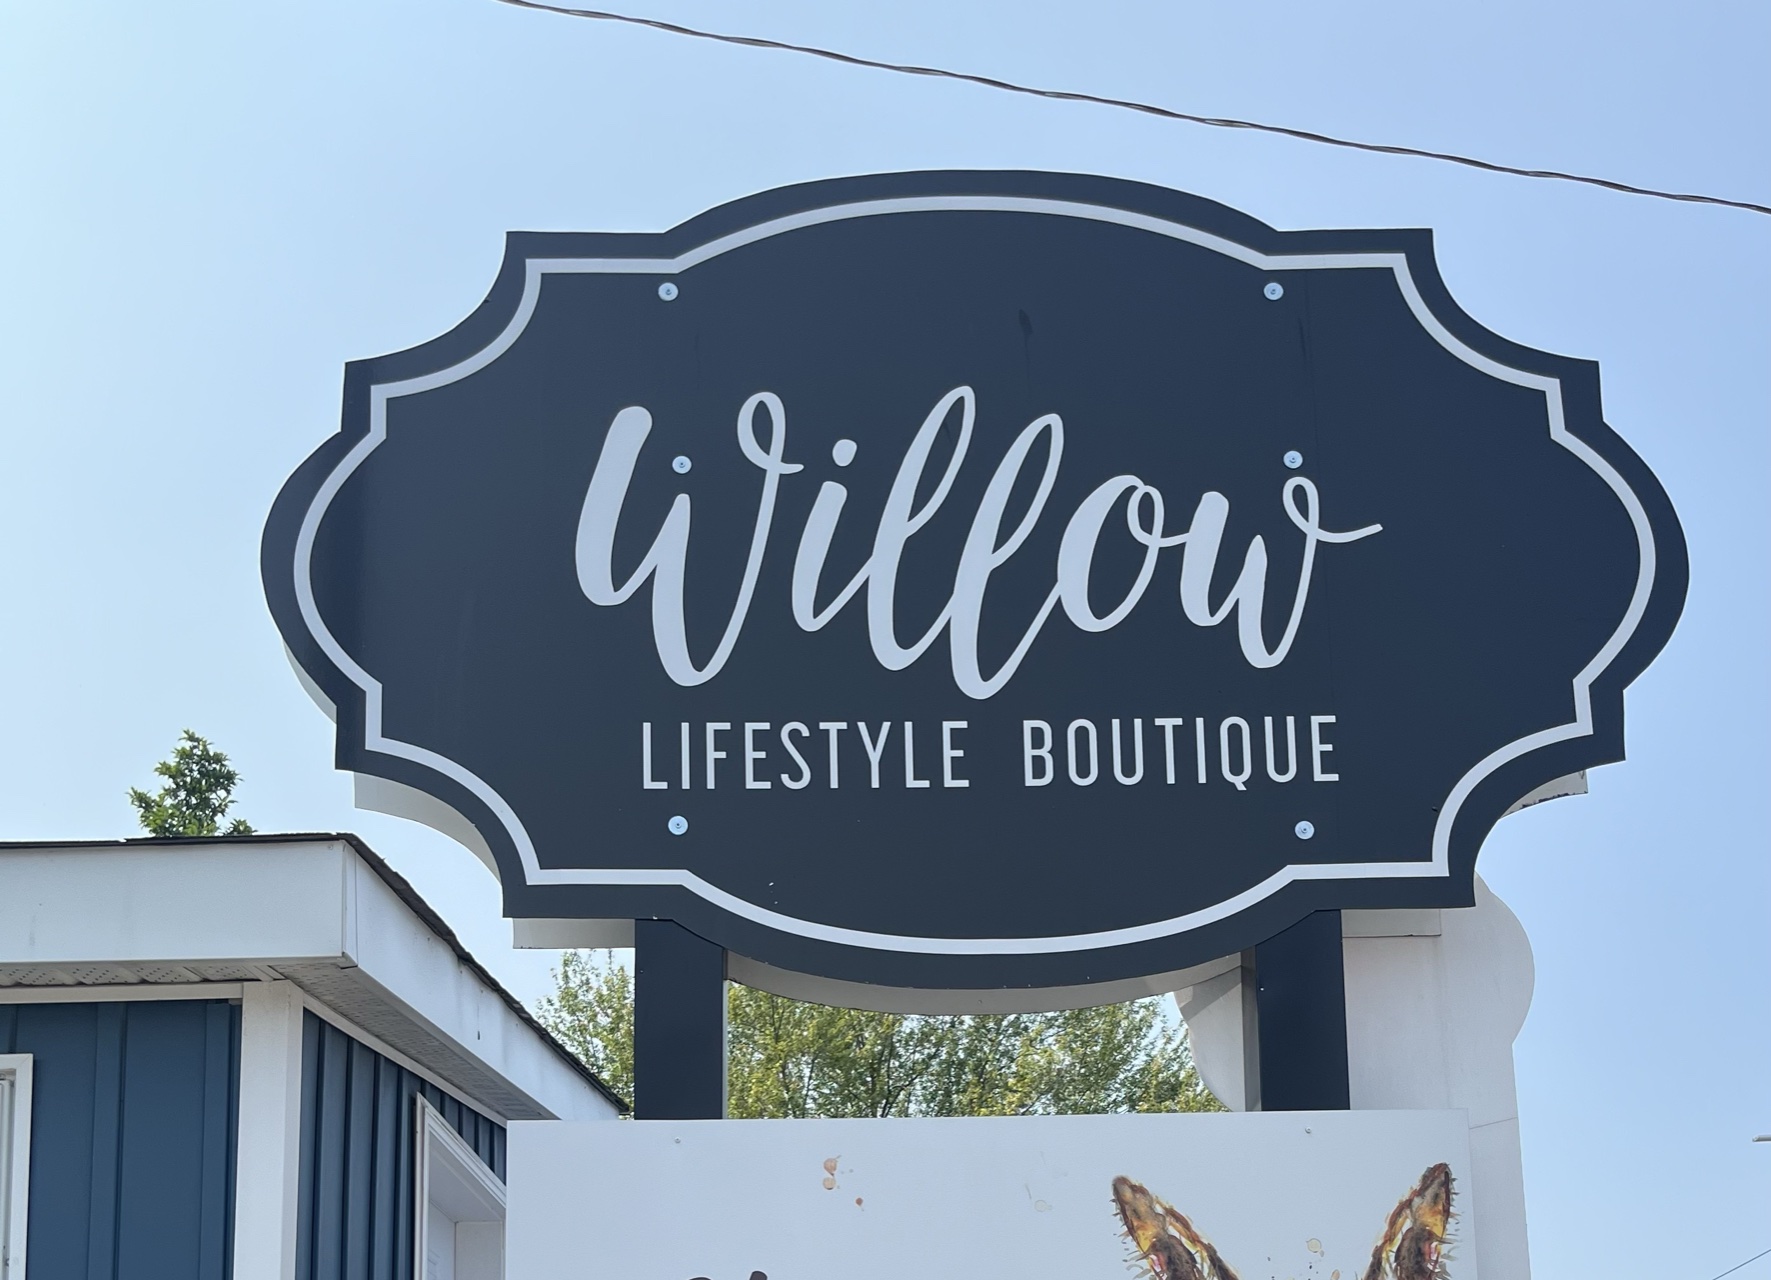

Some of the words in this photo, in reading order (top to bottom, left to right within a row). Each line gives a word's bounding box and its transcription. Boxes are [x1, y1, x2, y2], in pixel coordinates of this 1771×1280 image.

[576, 385, 1384, 700] Willow
[642, 721, 970, 790] LIFESTYLE
[1022, 715, 1340, 791] BOUTIQUE
